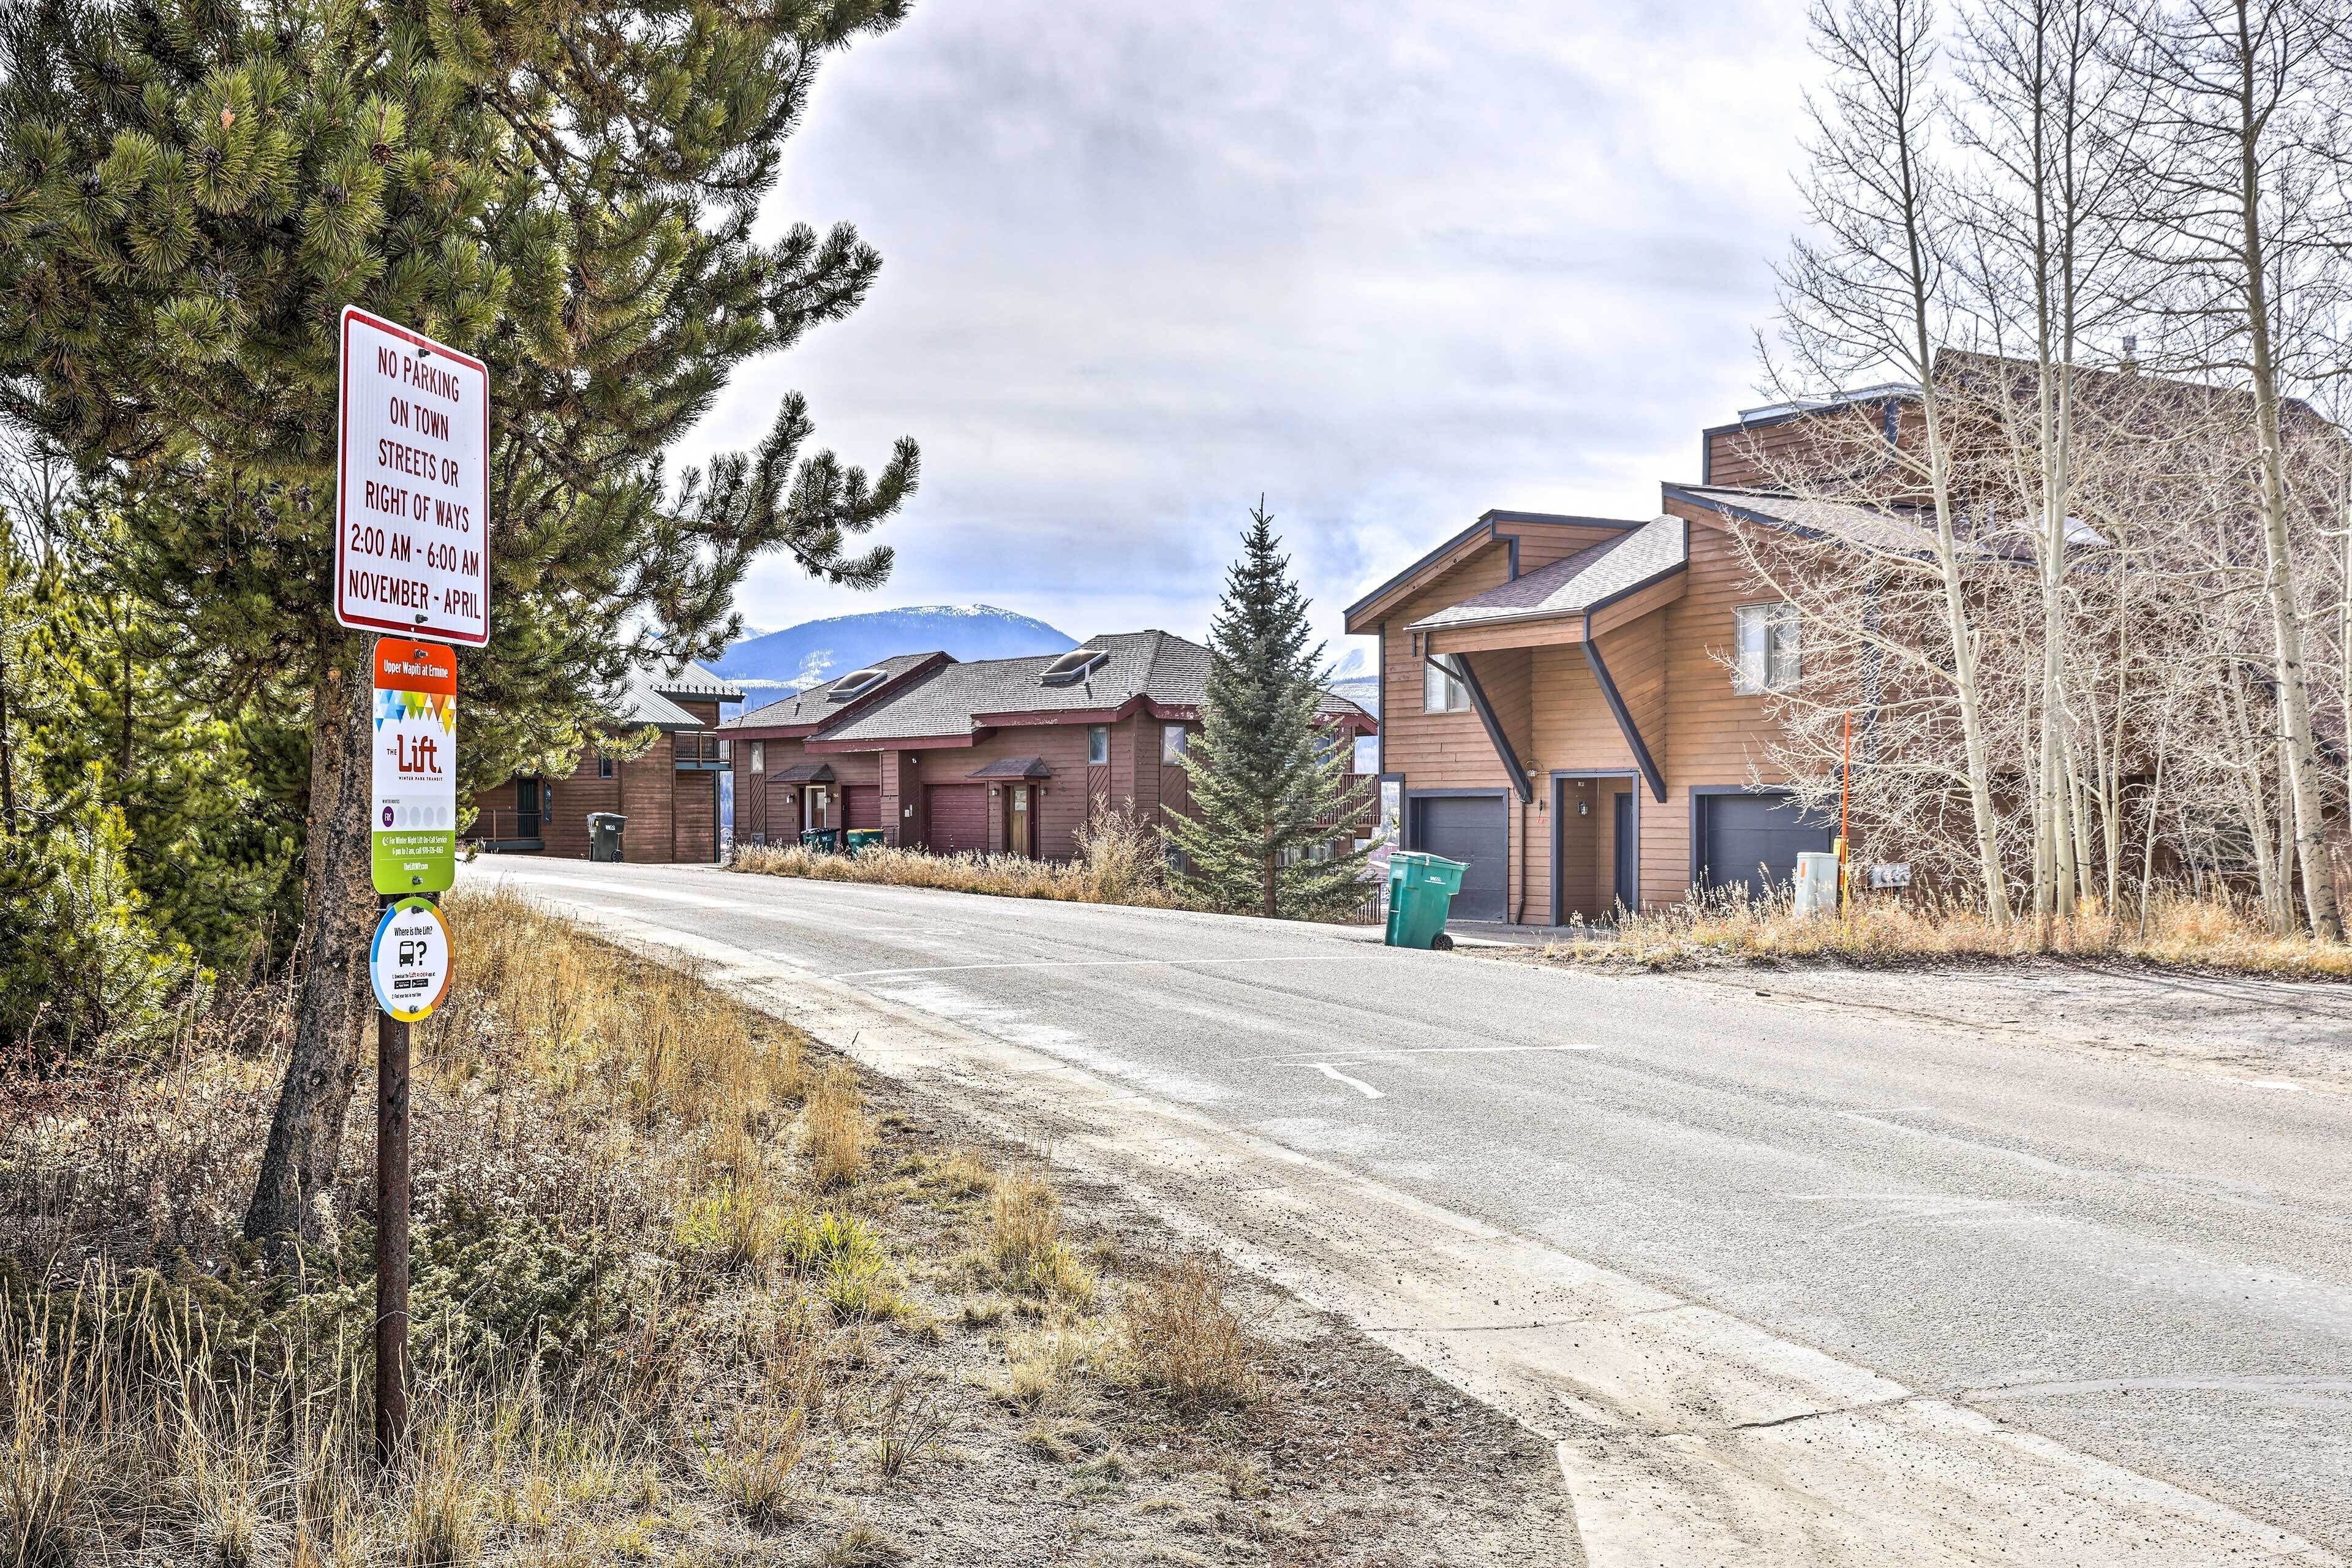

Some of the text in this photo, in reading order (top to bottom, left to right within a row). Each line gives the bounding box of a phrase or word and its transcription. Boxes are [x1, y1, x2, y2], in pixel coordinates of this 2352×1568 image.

[379, 346, 459, 402] NO PARKING
[390, 397, 449, 442] ON TOWN
[379, 439, 458, 488] STREETS OR
[366, 480, 469, 533] RIGHT OF WAYS
[351, 524, 384, 557] 2:00
[390, 533, 410, 562] AM
[428, 542, 456, 573] 6:00
[462, 549, 479, 577] AM
[349, 569, 428, 611] NOVEMBER
[444, 589, 480, 619] APRIL
[384, 659, 448, 678] Upper Wapiti at Ermine
[407, 836, 417, 845] Night
[394, 927, 409, 937] Where
[410, 926, 413, 935] is
[423, 925, 432, 935] Lift?
